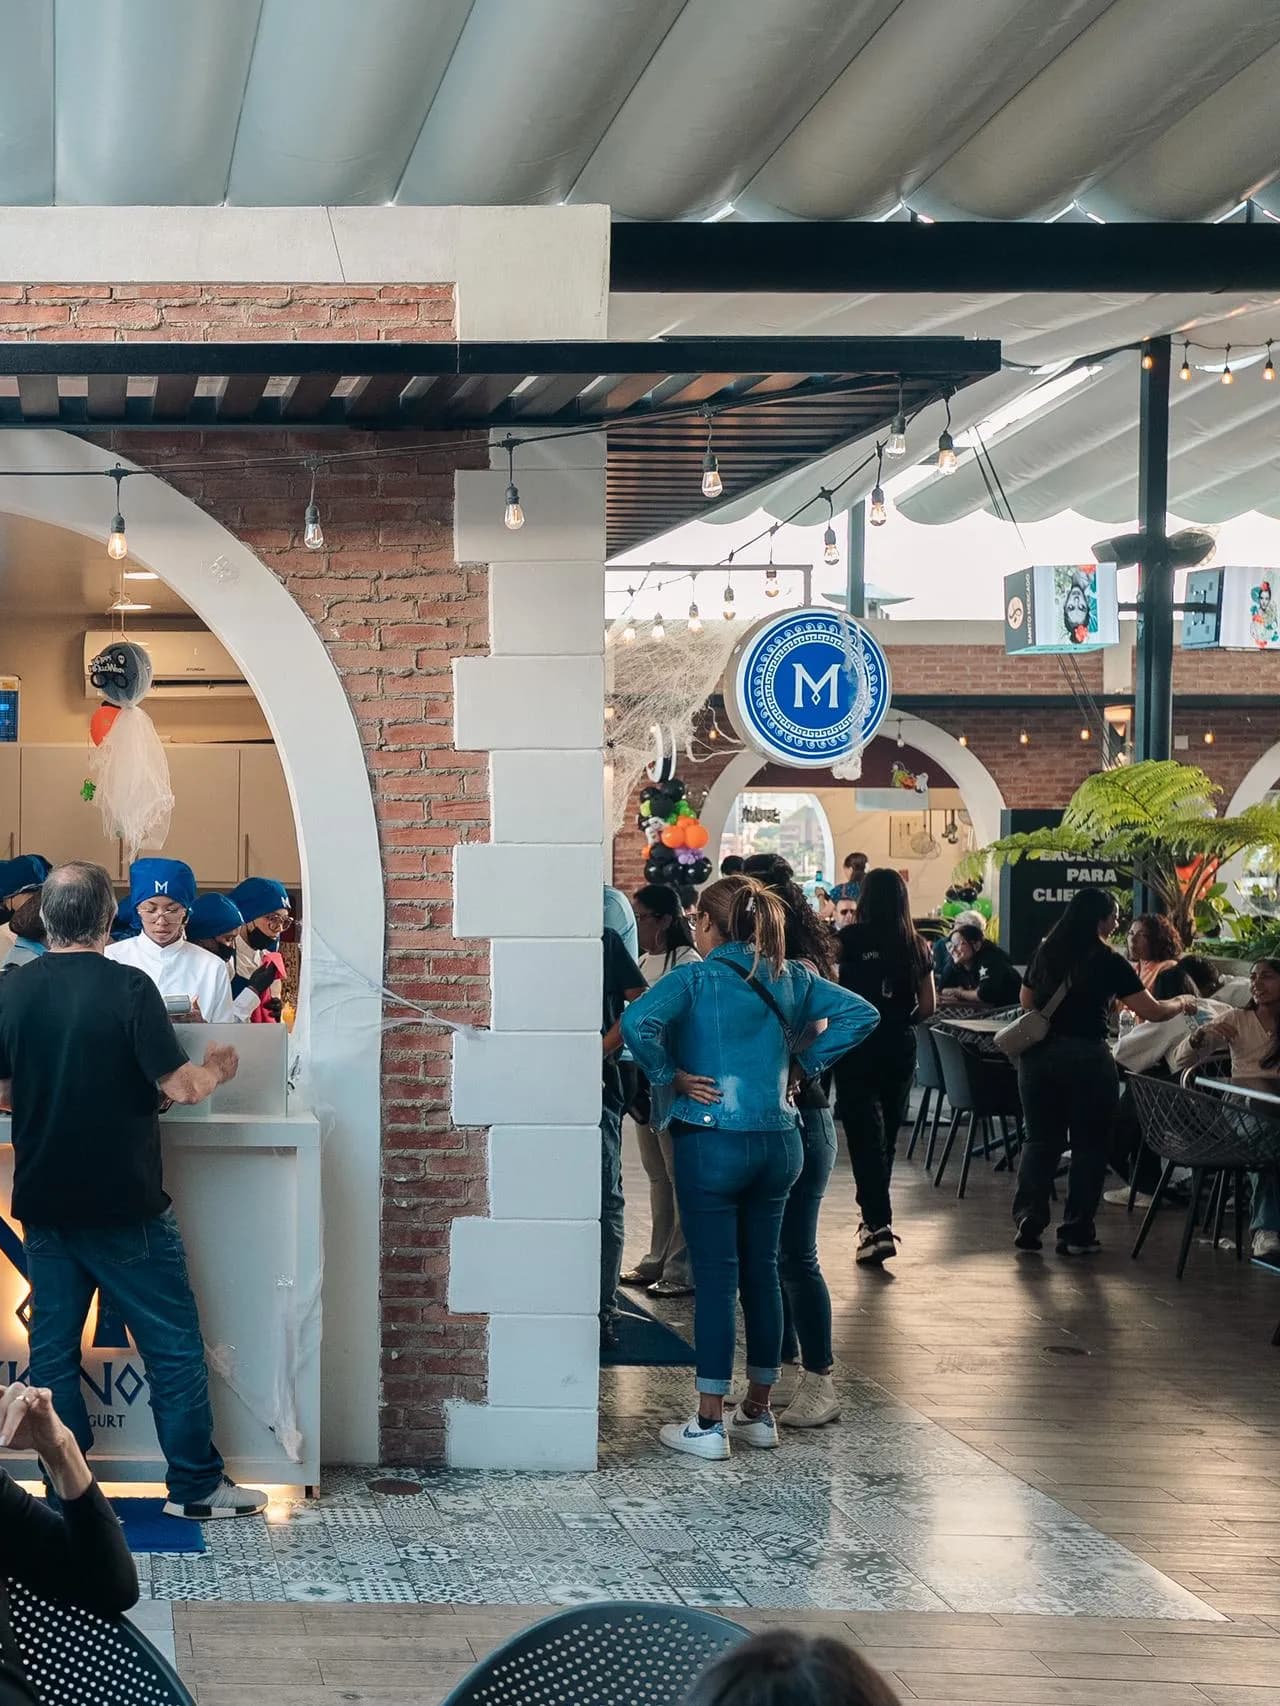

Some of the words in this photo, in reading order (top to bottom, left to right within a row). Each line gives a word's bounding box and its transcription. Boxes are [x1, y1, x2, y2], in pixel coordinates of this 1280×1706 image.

[792, 663, 841, 709] M
[1066, 868, 1118, 882] PARA
[155, 880, 169, 894] M
[1032, 888, 1081, 902] CLIE
[87, 1414, 126, 1429] GURT
